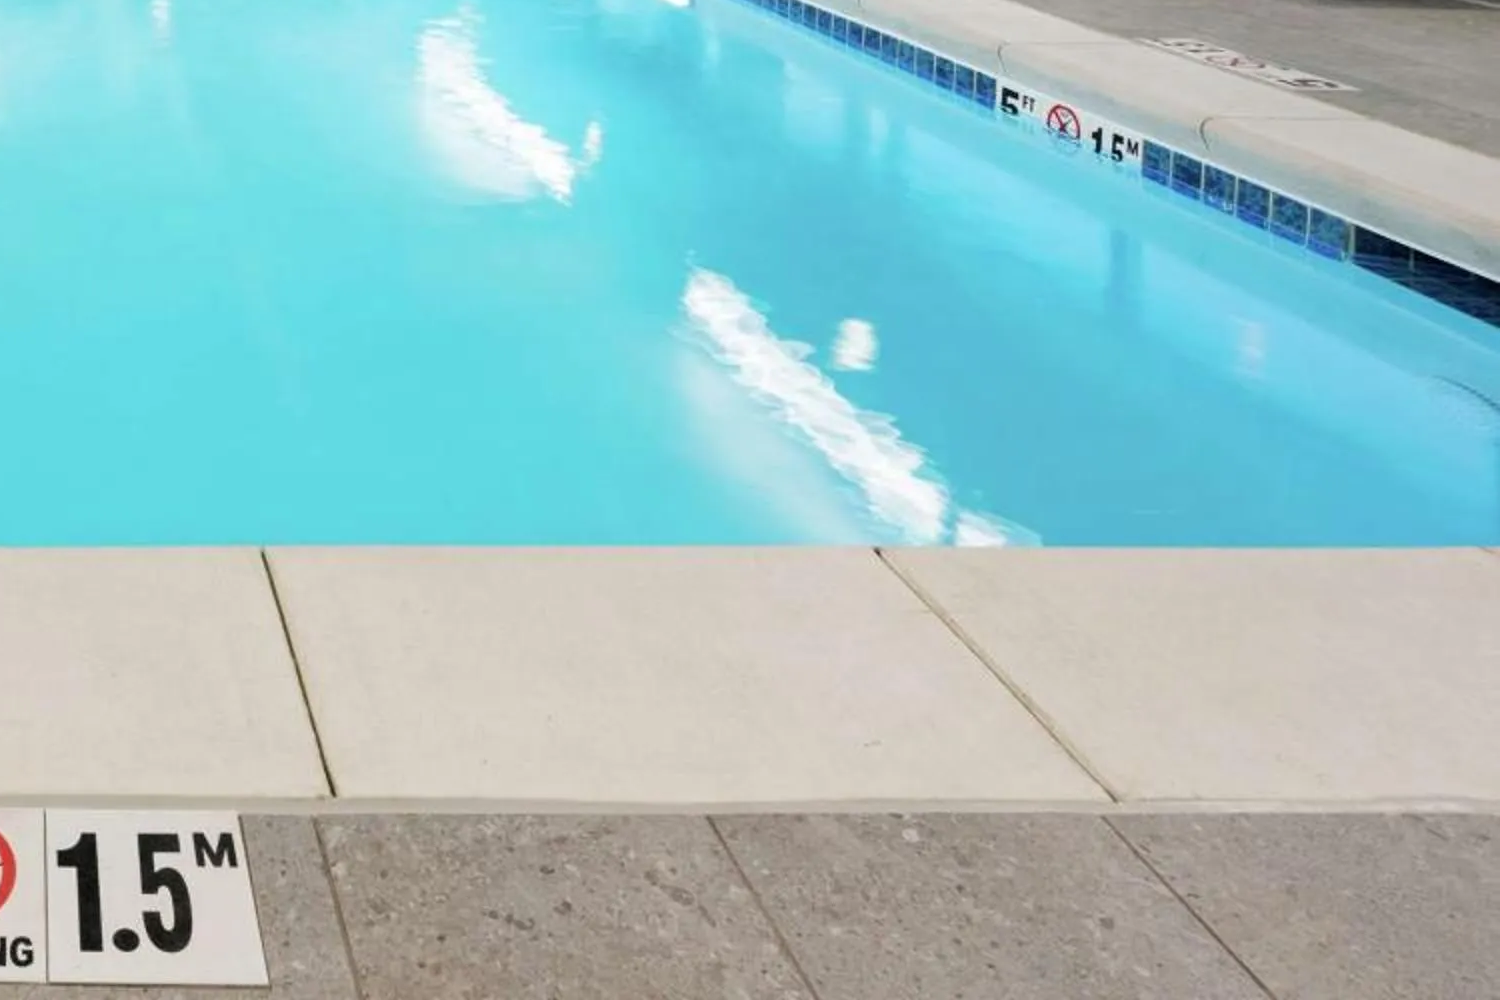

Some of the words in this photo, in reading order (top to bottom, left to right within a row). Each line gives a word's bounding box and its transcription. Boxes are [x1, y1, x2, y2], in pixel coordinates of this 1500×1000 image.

[1001, 86, 1019, 116] 5
[1022, 95, 1035, 113] FT
[1126, 138, 1139, 157] M
[56, 832, 193, 953] 1.5
[192, 832, 238, 867] M
